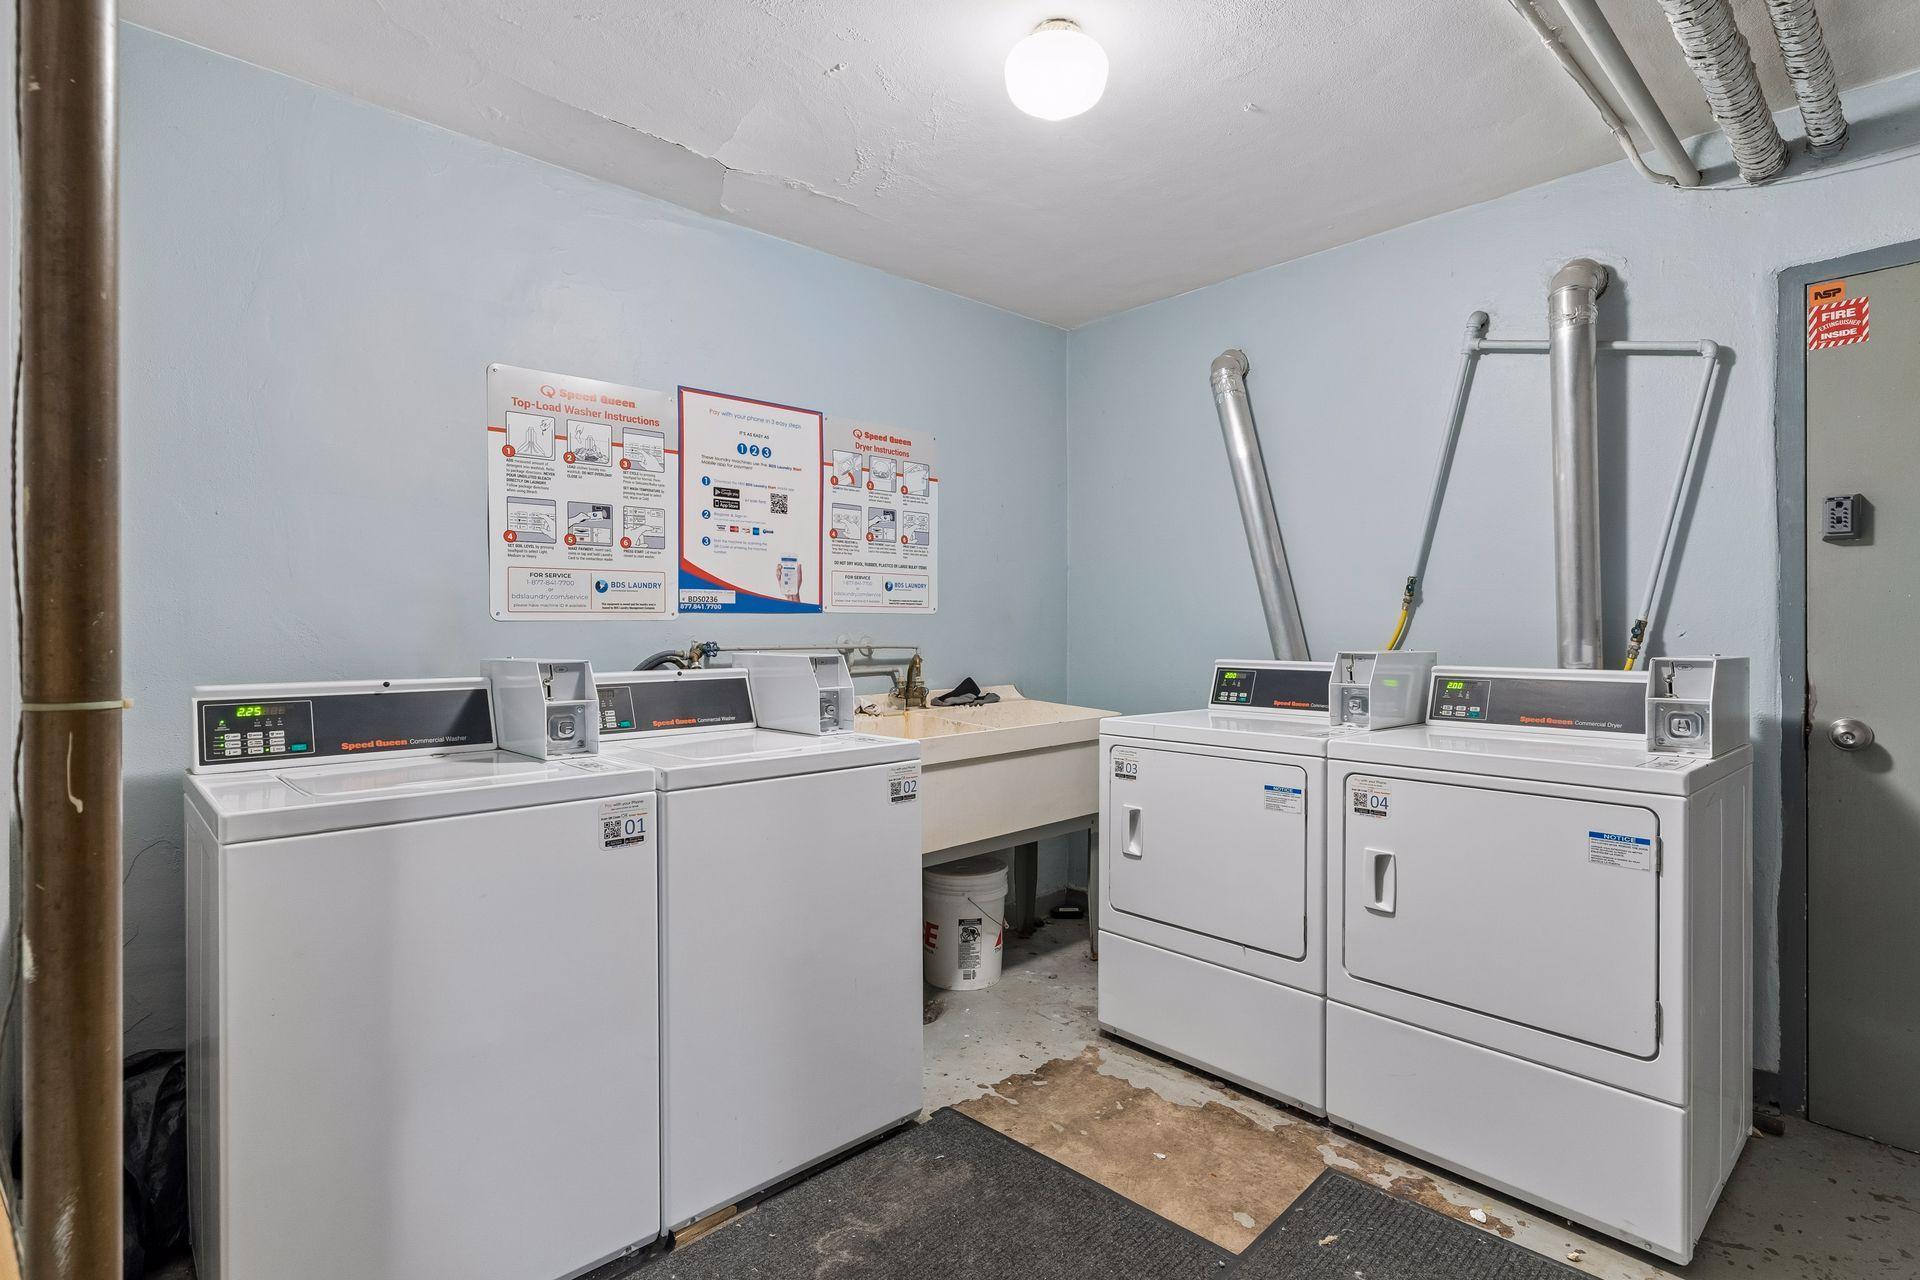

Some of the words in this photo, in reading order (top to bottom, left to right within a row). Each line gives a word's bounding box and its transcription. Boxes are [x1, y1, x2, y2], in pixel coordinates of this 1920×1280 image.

[1821, 308, 1857, 322] FIRE
[1818, 320, 1862, 332] EXTINGUISHER
[1821, 328, 1858, 340] INSIDE
[560, 390, 597, 403] Speed
[600, 394, 636, 409] Queen
[511, 397, 562, 413] Top-Load
[564, 405, 602, 419] Washer
[604, 409, 661, 427] Instructions
[709, 408, 720, 417] Pay
[864, 431, 888, 442] Speed
[889, 435, 912, 447] Queen
[855, 442, 873, 453] Dryer
[873, 445, 910, 458] Instructions
[610, 581, 626, 589] BDS
[628, 581, 662, 590] LAUNDRY
[511, 593, 589, 601] bdslaundry.com/service
[688, 595, 719, 603] BDS0236
[236, 706, 262, 717] 2.25
[652, 719, 674, 727] Speed
[1520, 716, 1545, 724] Speed
[1546, 717, 1573, 725] Queen
[1574, 720, 1606, 728] Commercial
[1606, 721, 1623, 729] Dryer
[341, 740, 374, 750] Speed
[375, 739, 408, 747] Queen
[409, 736, 445, 745] Commercial
[1125, 762, 1138, 774] 03
[903, 780, 917, 793] 02
[1370, 795, 1389, 810] 04
[625, 817, 646, 835] 01
[1603, 833, 1636, 843] NOTICE
